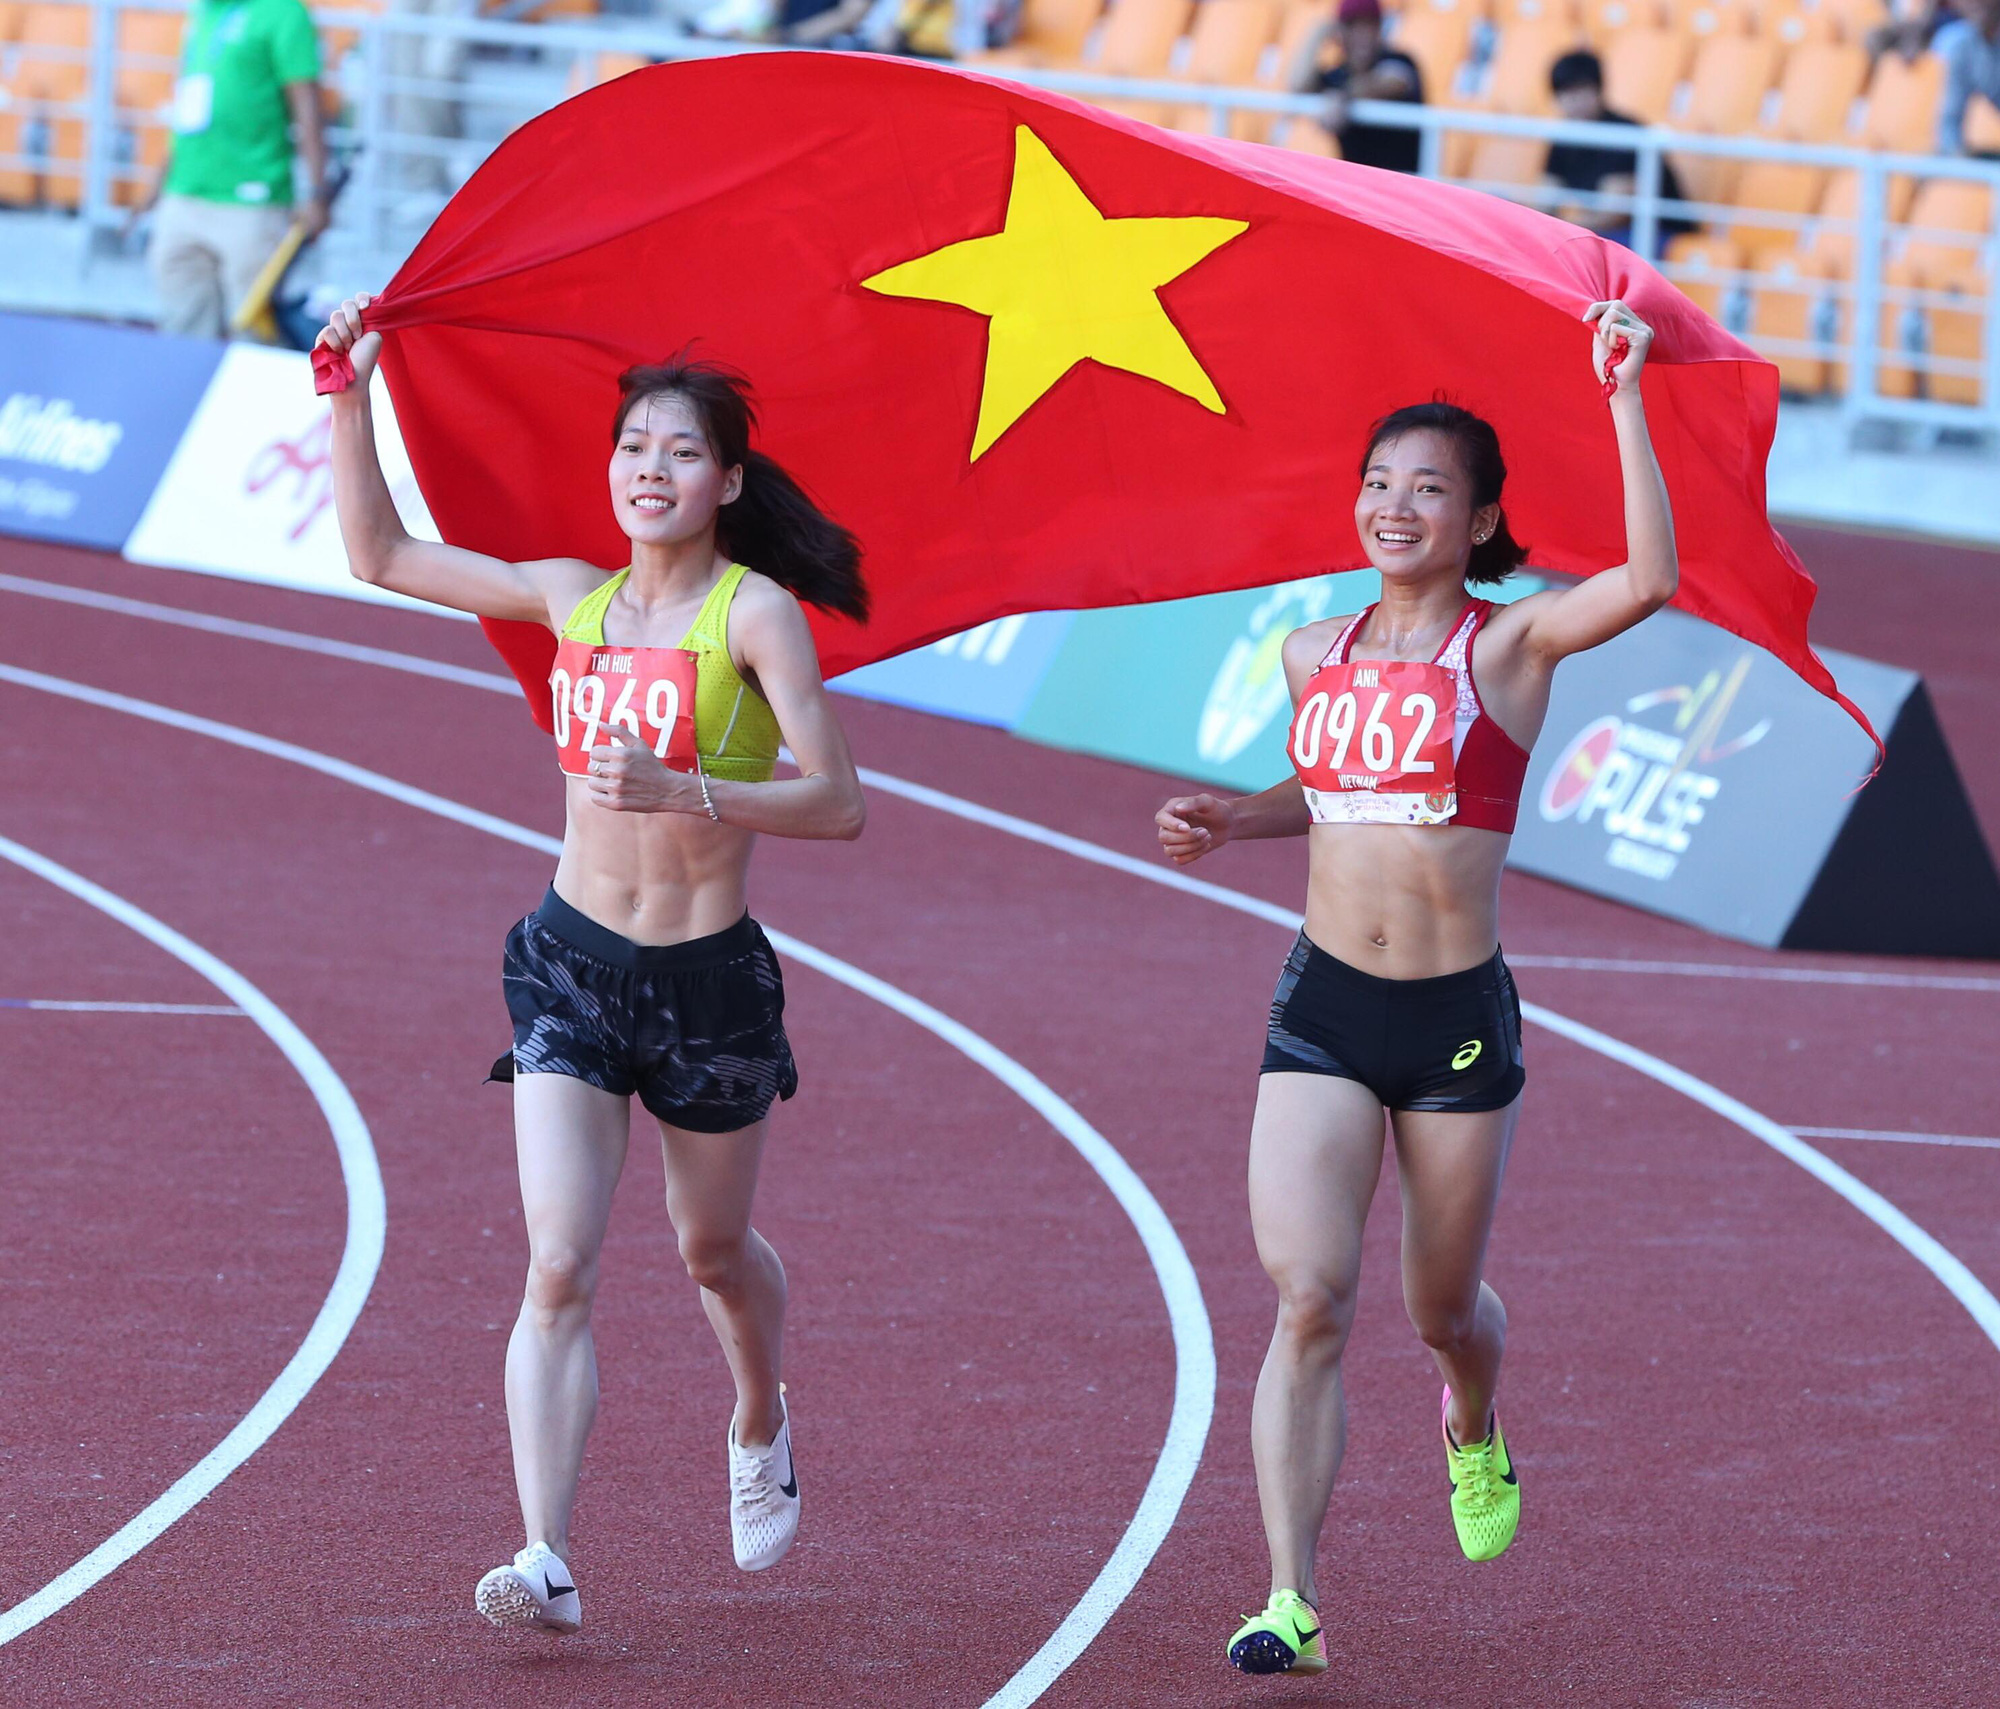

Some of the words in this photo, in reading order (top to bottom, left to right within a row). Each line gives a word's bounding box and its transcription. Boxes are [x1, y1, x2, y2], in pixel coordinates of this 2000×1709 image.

[592, 653, 610, 672] THI
[611, 654, 633, 674] HUE
[551, 668, 679, 758] 0969
[1294, 692, 1436, 773] 0962
[1338, 774, 1378, 790] VIETNAM
